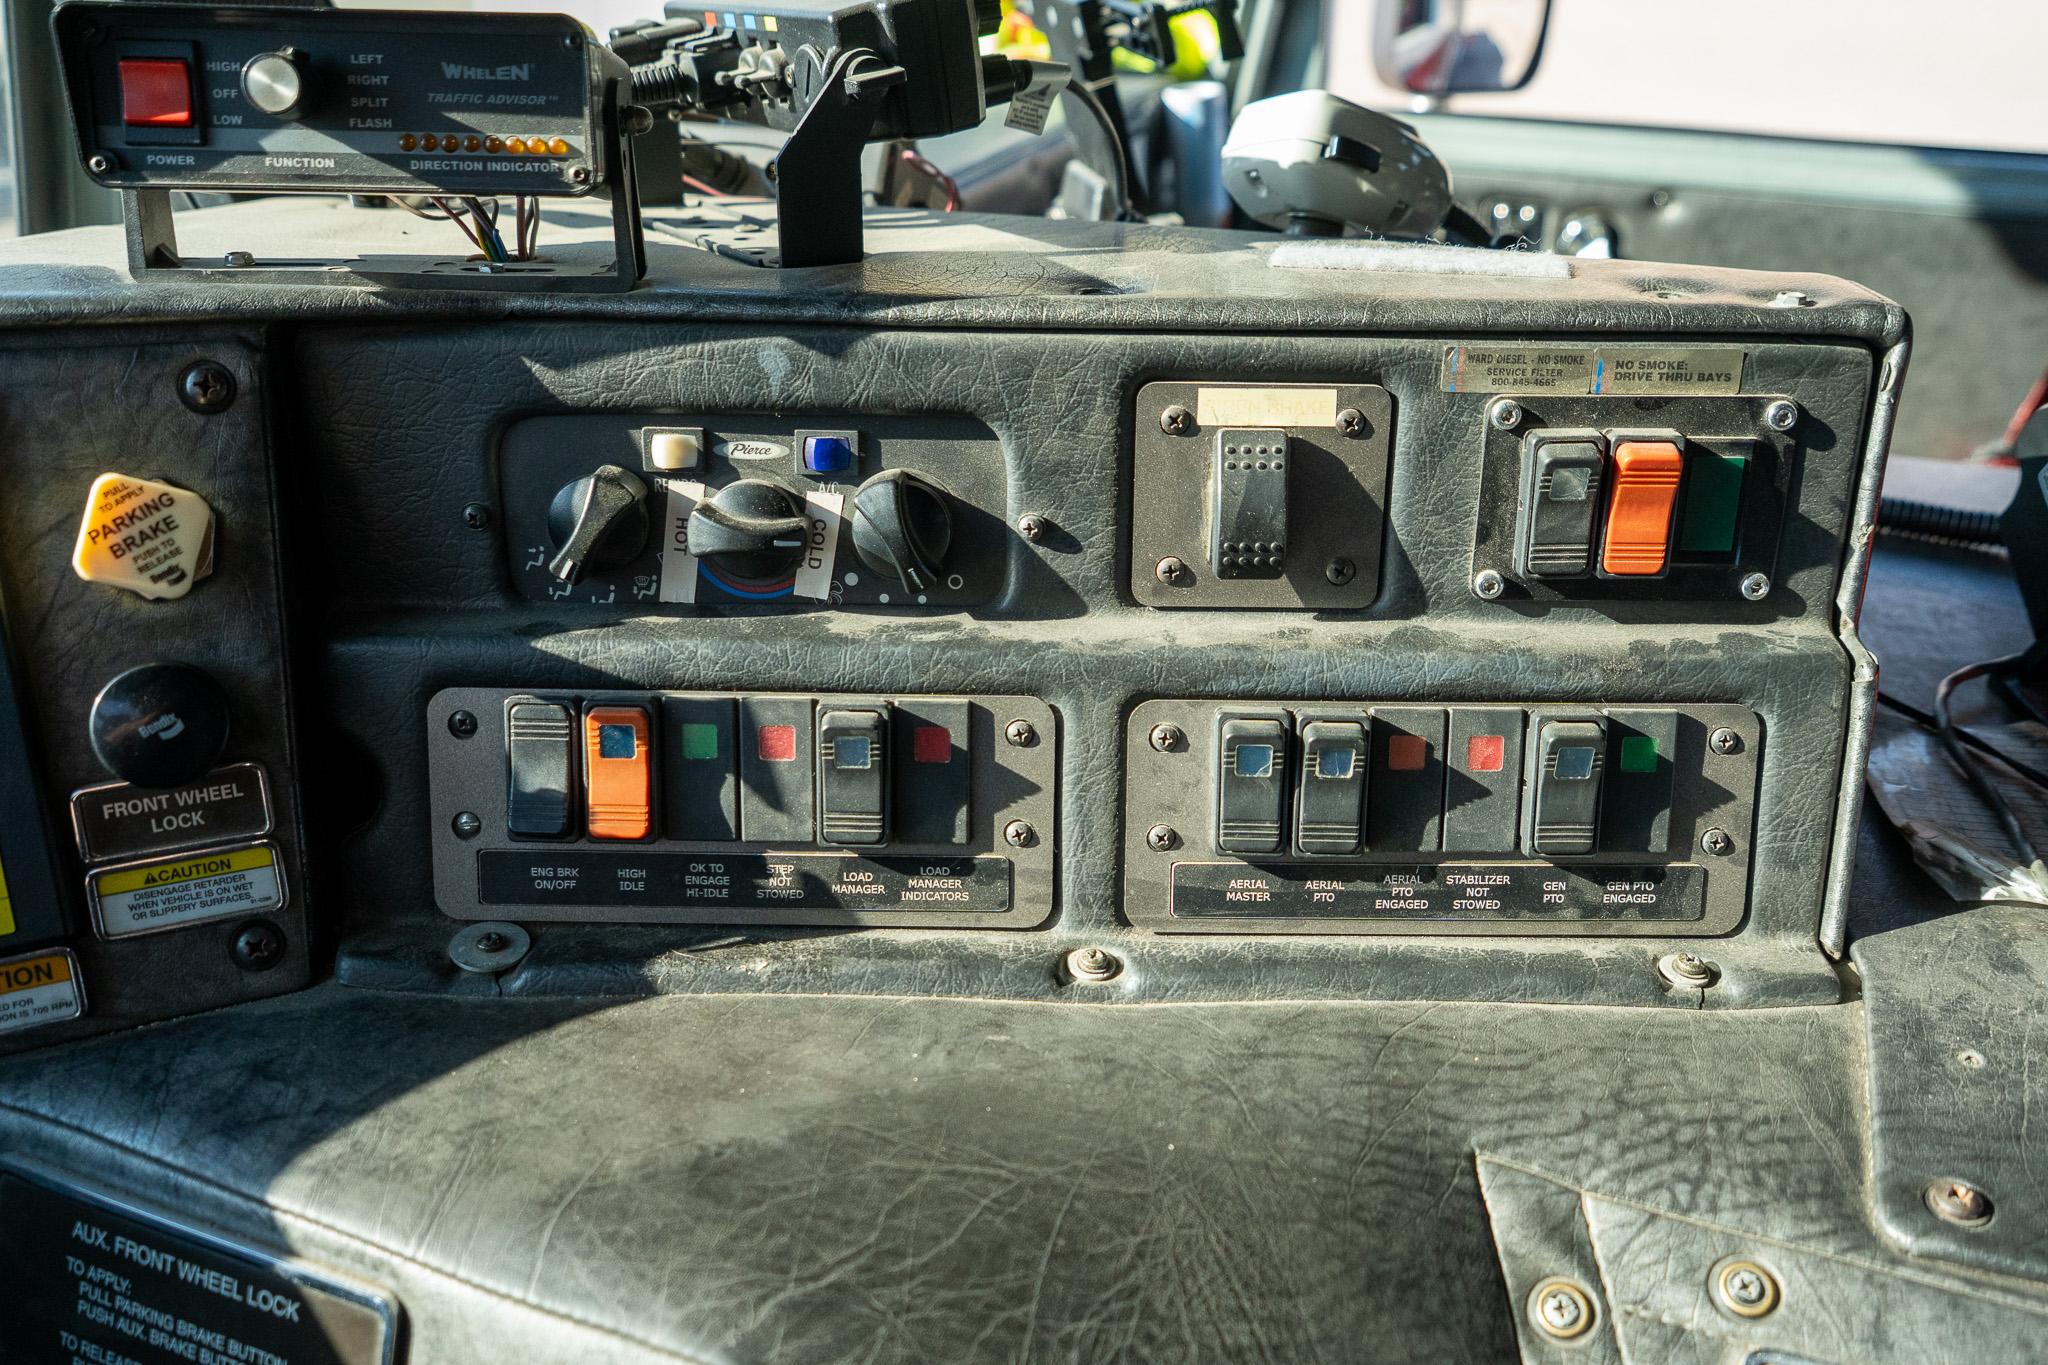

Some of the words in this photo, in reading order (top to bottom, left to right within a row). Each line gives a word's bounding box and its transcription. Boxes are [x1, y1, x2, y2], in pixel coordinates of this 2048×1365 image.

[351, 54, 384, 65] LEFT
[206, 61, 241, 72] HIGH
[347, 74, 390, 86] RIGHT
[212, 88, 239, 99] OFF
[427, 93, 483, 104] TRAFFIC
[351, 97, 390, 108] SPLIT
[213, 115, 243, 126] LOW
[349, 117, 392, 129] FLASH
[147, 155, 196, 166] POWER
[265, 156, 336, 169] FUNCTION
[411, 160, 483, 171] DIRECTION
[487, 161, 560, 173] INDICATOR
[1468, 354, 1493, 365] WARD
[1496, 354, 1527, 365] DIESEL
[1538, 354, 1551, 365] NO
[1553, 354, 1585, 366] SMOKE
[1616, 360, 1636, 370] NO
[1487, 367, 1526, 377] SERVICE
[1531, 368, 1563, 378] FILTER
[1614, 371, 1653, 382] DRIVE
[1657, 372, 1693, 382] THRU
[1696, 372, 1732, 383] BAYS
[730, 443, 773, 456] Pierce
[103, 482, 129, 497] PULL
[99, 503, 113, 513] TO
[114, 486, 144, 508] APPLY
[88, 492, 175, 544] PARKING
[109, 515, 179, 559] BRAKE
[673, 517, 688, 555] HOT
[808, 519, 827, 570] COLD
[133, 546, 160, 563] PUSH
[161, 538, 175, 551] TO
[137, 547, 183, 574] RELEASE
[103, 794, 170, 820] FRONT
[175, 783, 244, 807] WHEEL
[151, 810, 205, 833] LOCK
[158, 858, 231, 882] CAUTION
[531, 867, 552, 877] ENG
[557, 867, 579, 877] BRK
[618, 869, 646, 878] HIGH
[690, 863, 706, 873] OK
[709, 864, 724, 873] TO
[766, 864, 794, 874] STEP
[920, 866, 950, 876] LOAD
[685, 875, 730, 885] ENGAGE
[769, 877, 792, 887] NOT
[843, 872, 873, 882] LOAD
[1383, 874, 1424, 884] AERIAL
[1446, 875, 1511, 885] STABILIZER
[133, 881, 191, 900] DISENGAGE
[193, 873, 246, 892] RETARDER
[535, 880, 576, 890] ON/OFF
[620, 881, 645, 891] IDLE
[832, 884, 886, 895] MANAGER
[908, 879, 963, 889] MANAGER
[1229, 879, 1269, 889] AERIAL
[1305, 880, 1345, 890] AERIAL
[1543, 881, 1566, 891] GEN
[1606, 881, 1630, 891] GEN
[1633, 881, 1655, 891] PTO
[128, 900, 158, 912] WHEN
[160, 891, 203, 907] VEHICLE
[204, 889, 215, 898] IS
[216, 887, 231, 898] ON
[232, 882, 254, 894] WET
[686, 888, 729, 898] HI-IDLE
[757, 889, 804, 899] STOWED
[901, 891, 969, 901] INDICATORS
[1226, 892, 1271, 902] MASTER
[1313, 893, 1335, 902] PTO
[1392, 887, 1414, 897] PTO
[1466, 887, 1490, 897] NOT
[1543, 894, 1565, 903] PTO
[1603, 893, 1656, 904] ENGAGED
[1375, 899, 1429, 910] ENGAGED
[1453, 900, 1501, 910] STOWED
[132, 910, 148, 921] OR
[150, 902, 198, 918] SLIPPERY
[66, 1256, 85, 1276] TO
[72, 1221, 111, 1250] AUX.
[114, 1235, 175, 1274] FRONT
[178, 1259, 243, 1301] WHEEL
[246, 1285, 301, 1322] LOCK
[79, 1280, 112, 1307] PULL
[115, 1295, 174, 1331] PARKING
[176, 1319, 226, 1350] BRAKE
[77, 1300, 114, 1326] PUSH
[117, 1320, 147, 1341] AUX.
[149, 1328, 197, 1360] BRAKE
[59, 1331, 78, 1351] TO
